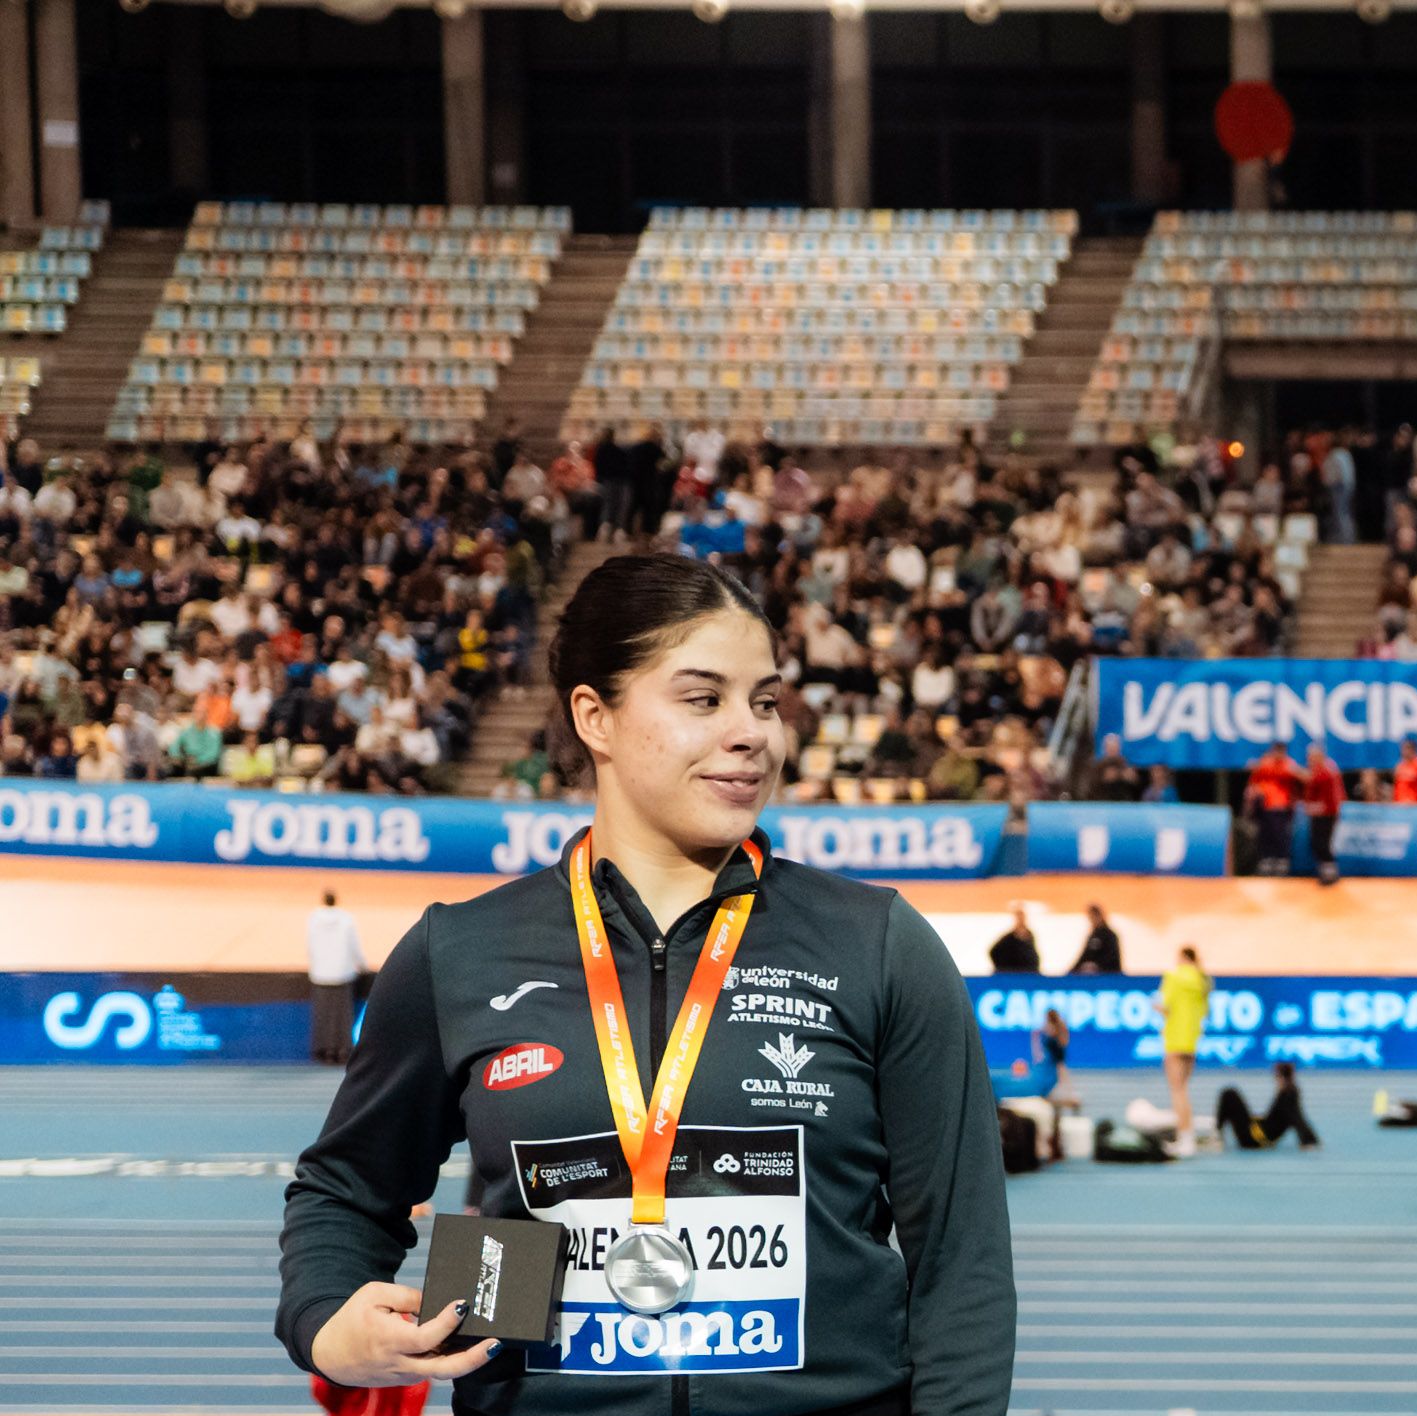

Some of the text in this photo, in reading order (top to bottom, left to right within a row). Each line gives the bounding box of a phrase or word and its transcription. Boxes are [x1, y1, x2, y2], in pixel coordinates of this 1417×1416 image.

[0, 788, 158, 848] oma
[214, 799, 431, 863] Joma
[490, 811, 594, 874] Jo
[773, 815, 983, 870] Joma
[741, 965, 839, 991] universidad
[754, 974, 791, 989] león
[727, 1012, 801, 1026] ATLETISMO
[731, 993, 832, 1023] SPRINT
[976, 989, 1264, 1032] CAMPEOTO
[487, 1047, 554, 1087] ABRIL
[741, 1078, 835, 1097] CAJA RURAL
[750, 1097, 813, 1110] somos León
[540, 1161, 598, 1179] COMUNITAT
[743, 1158, 794, 1167] TRINIDAD
[743, 1167, 794, 1176] ALFONSO
[546, 1168, 609, 1188] DE L'ESPORT
[707, 1225, 788, 1270] 2026
[591, 1310, 783, 1365] Joma
